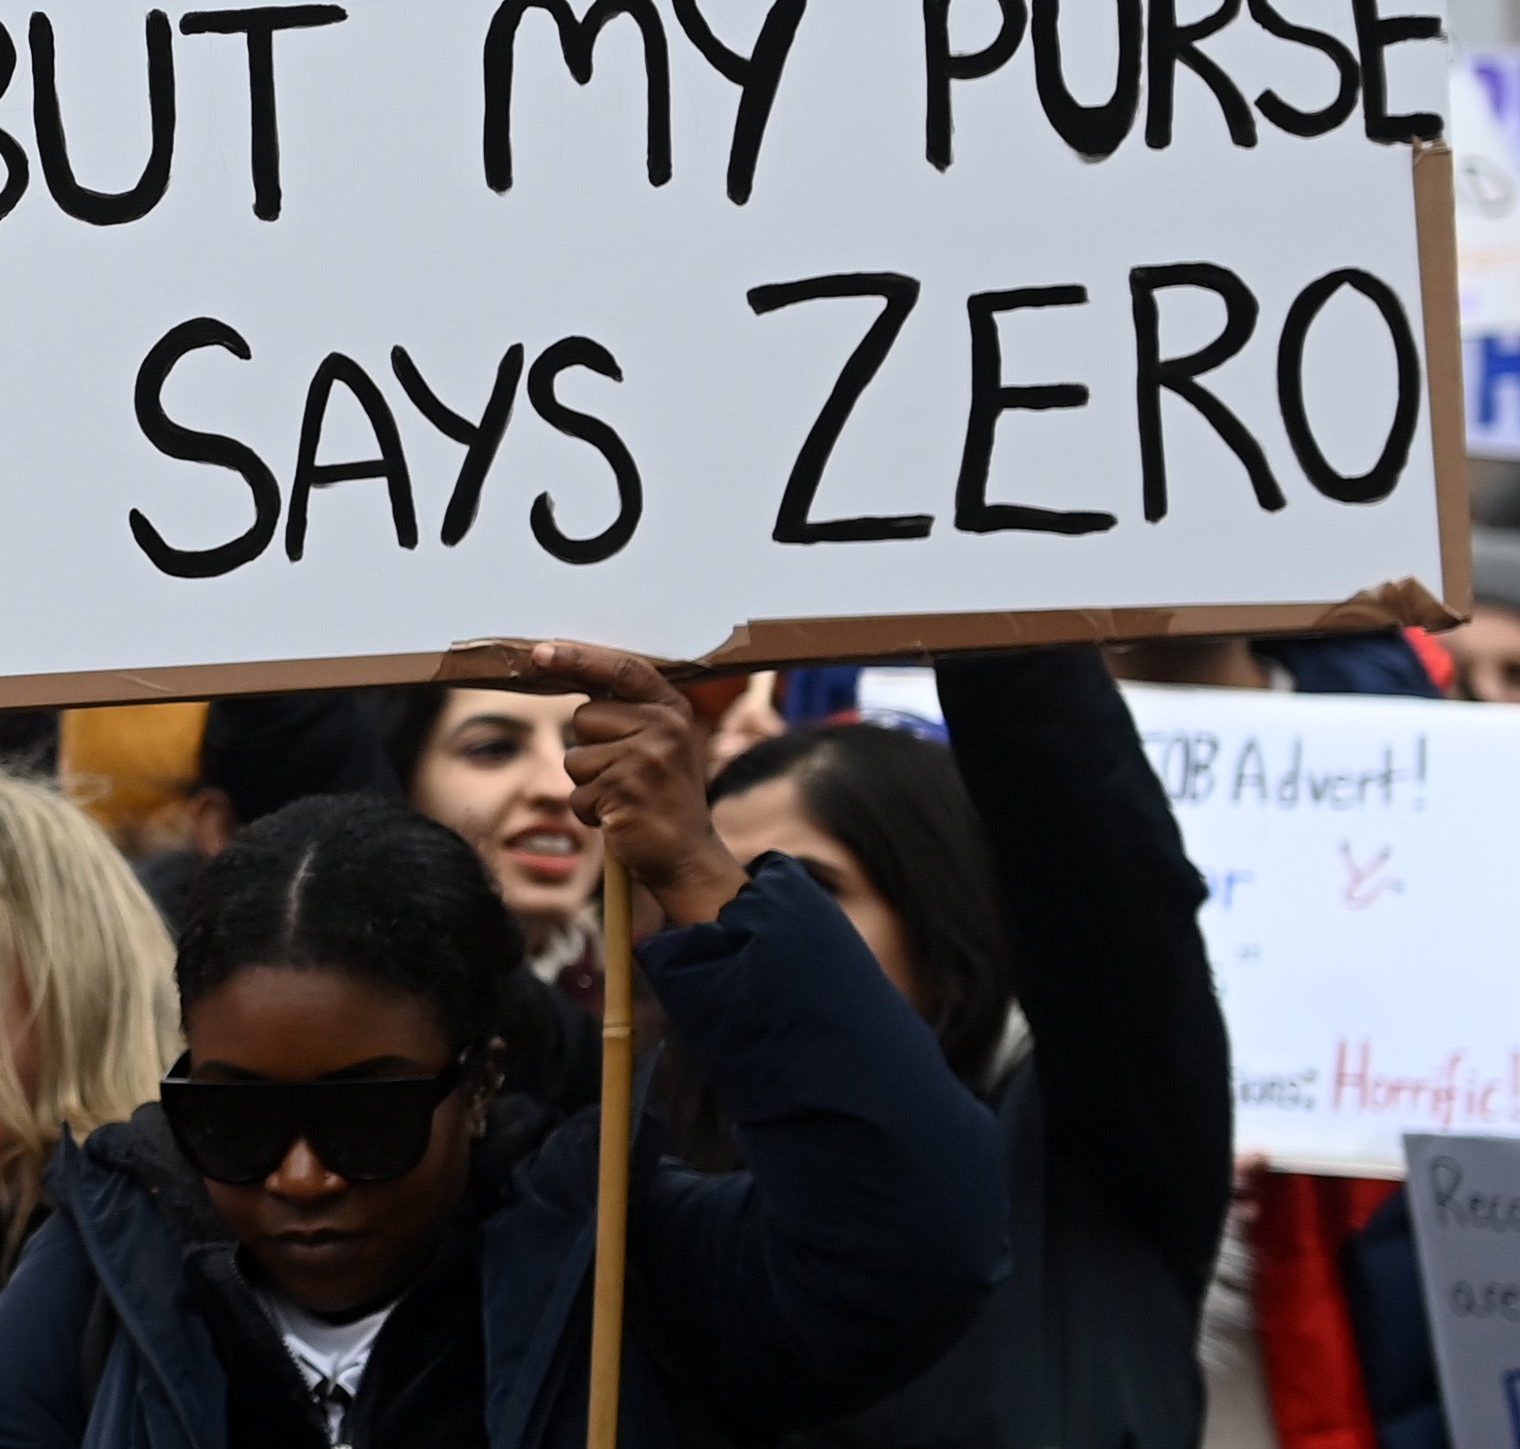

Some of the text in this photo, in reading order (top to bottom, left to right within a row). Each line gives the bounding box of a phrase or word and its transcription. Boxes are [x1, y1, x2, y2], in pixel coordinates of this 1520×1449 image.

[129, 261, 1421, 579] SAYS ZERO
[1231, 731, 1428, 812] Advert!
